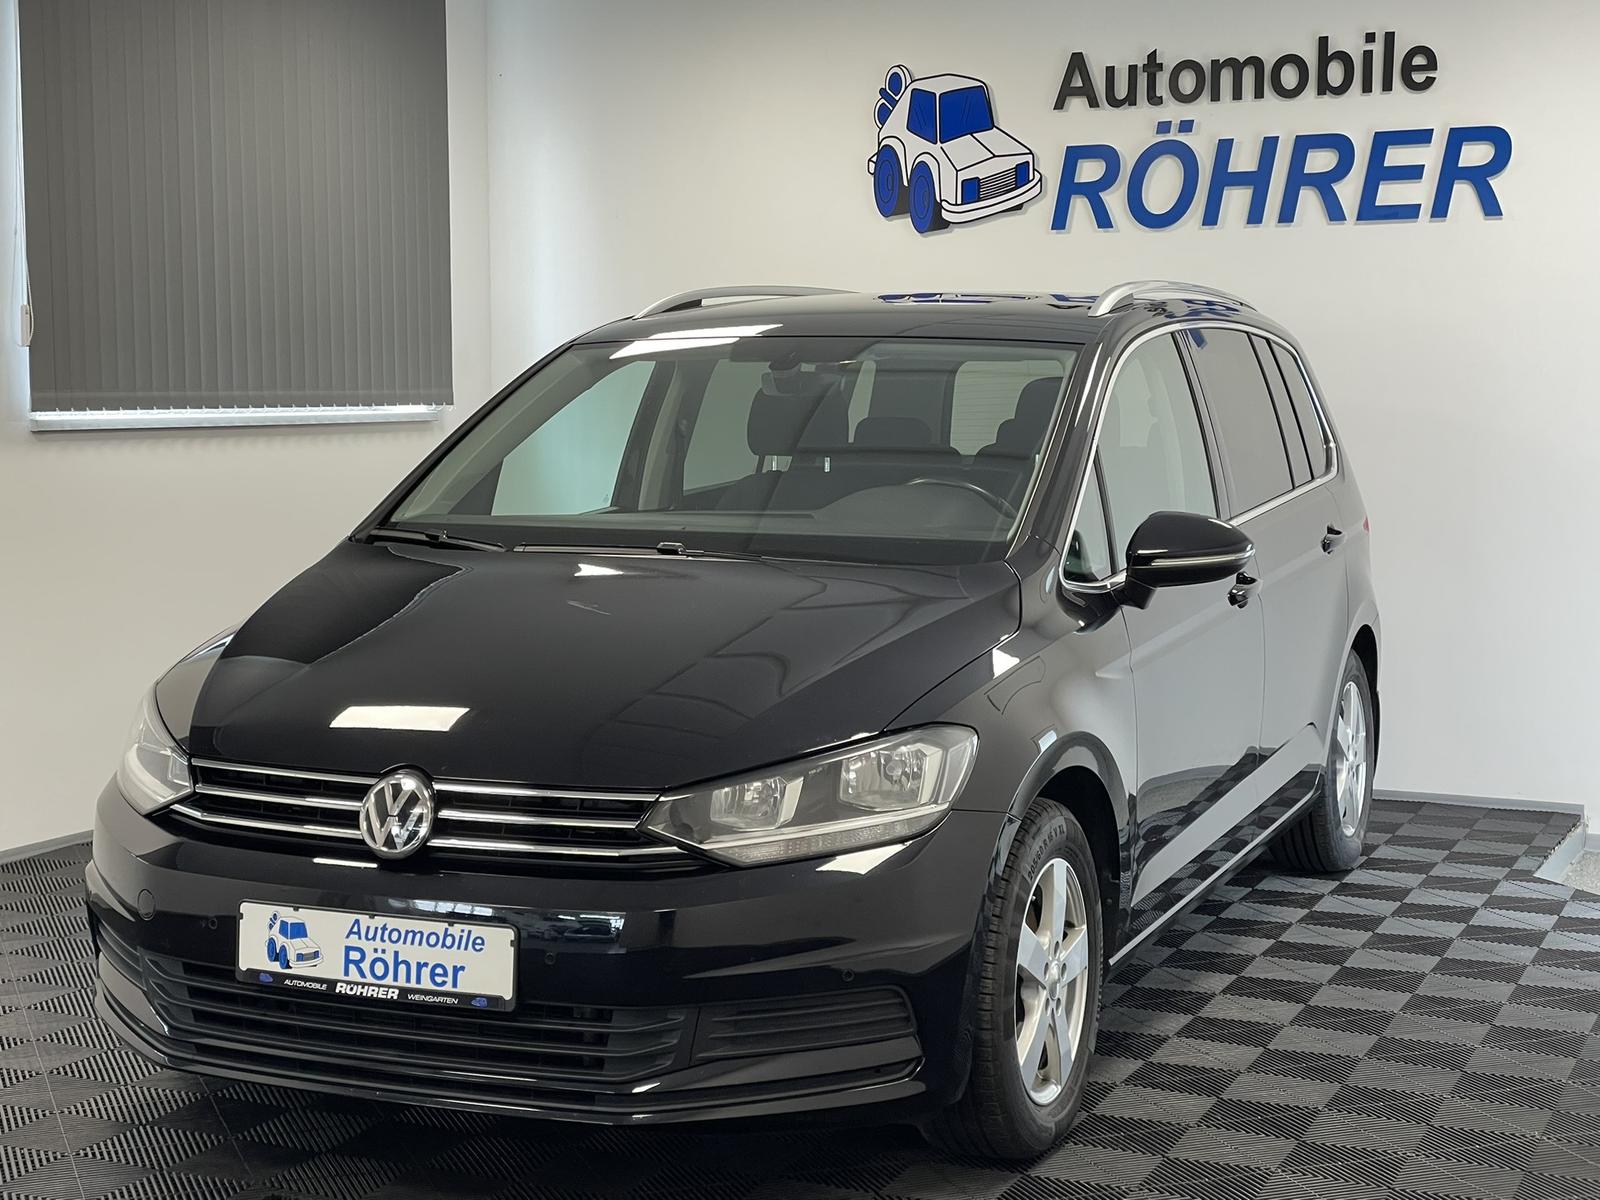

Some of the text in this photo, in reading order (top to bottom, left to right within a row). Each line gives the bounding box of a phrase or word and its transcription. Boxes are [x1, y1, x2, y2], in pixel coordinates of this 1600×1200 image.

[1053, 31, 1438, 111] Automobile
[1050, 119, 1513, 232] RÖHRER
[345, 918, 486, 952] Automobile
[342, 945, 466, 989] Röhrer
[283, 979, 459, 1005] AUTOMOBILE RÖHRER WEINGARTEN
